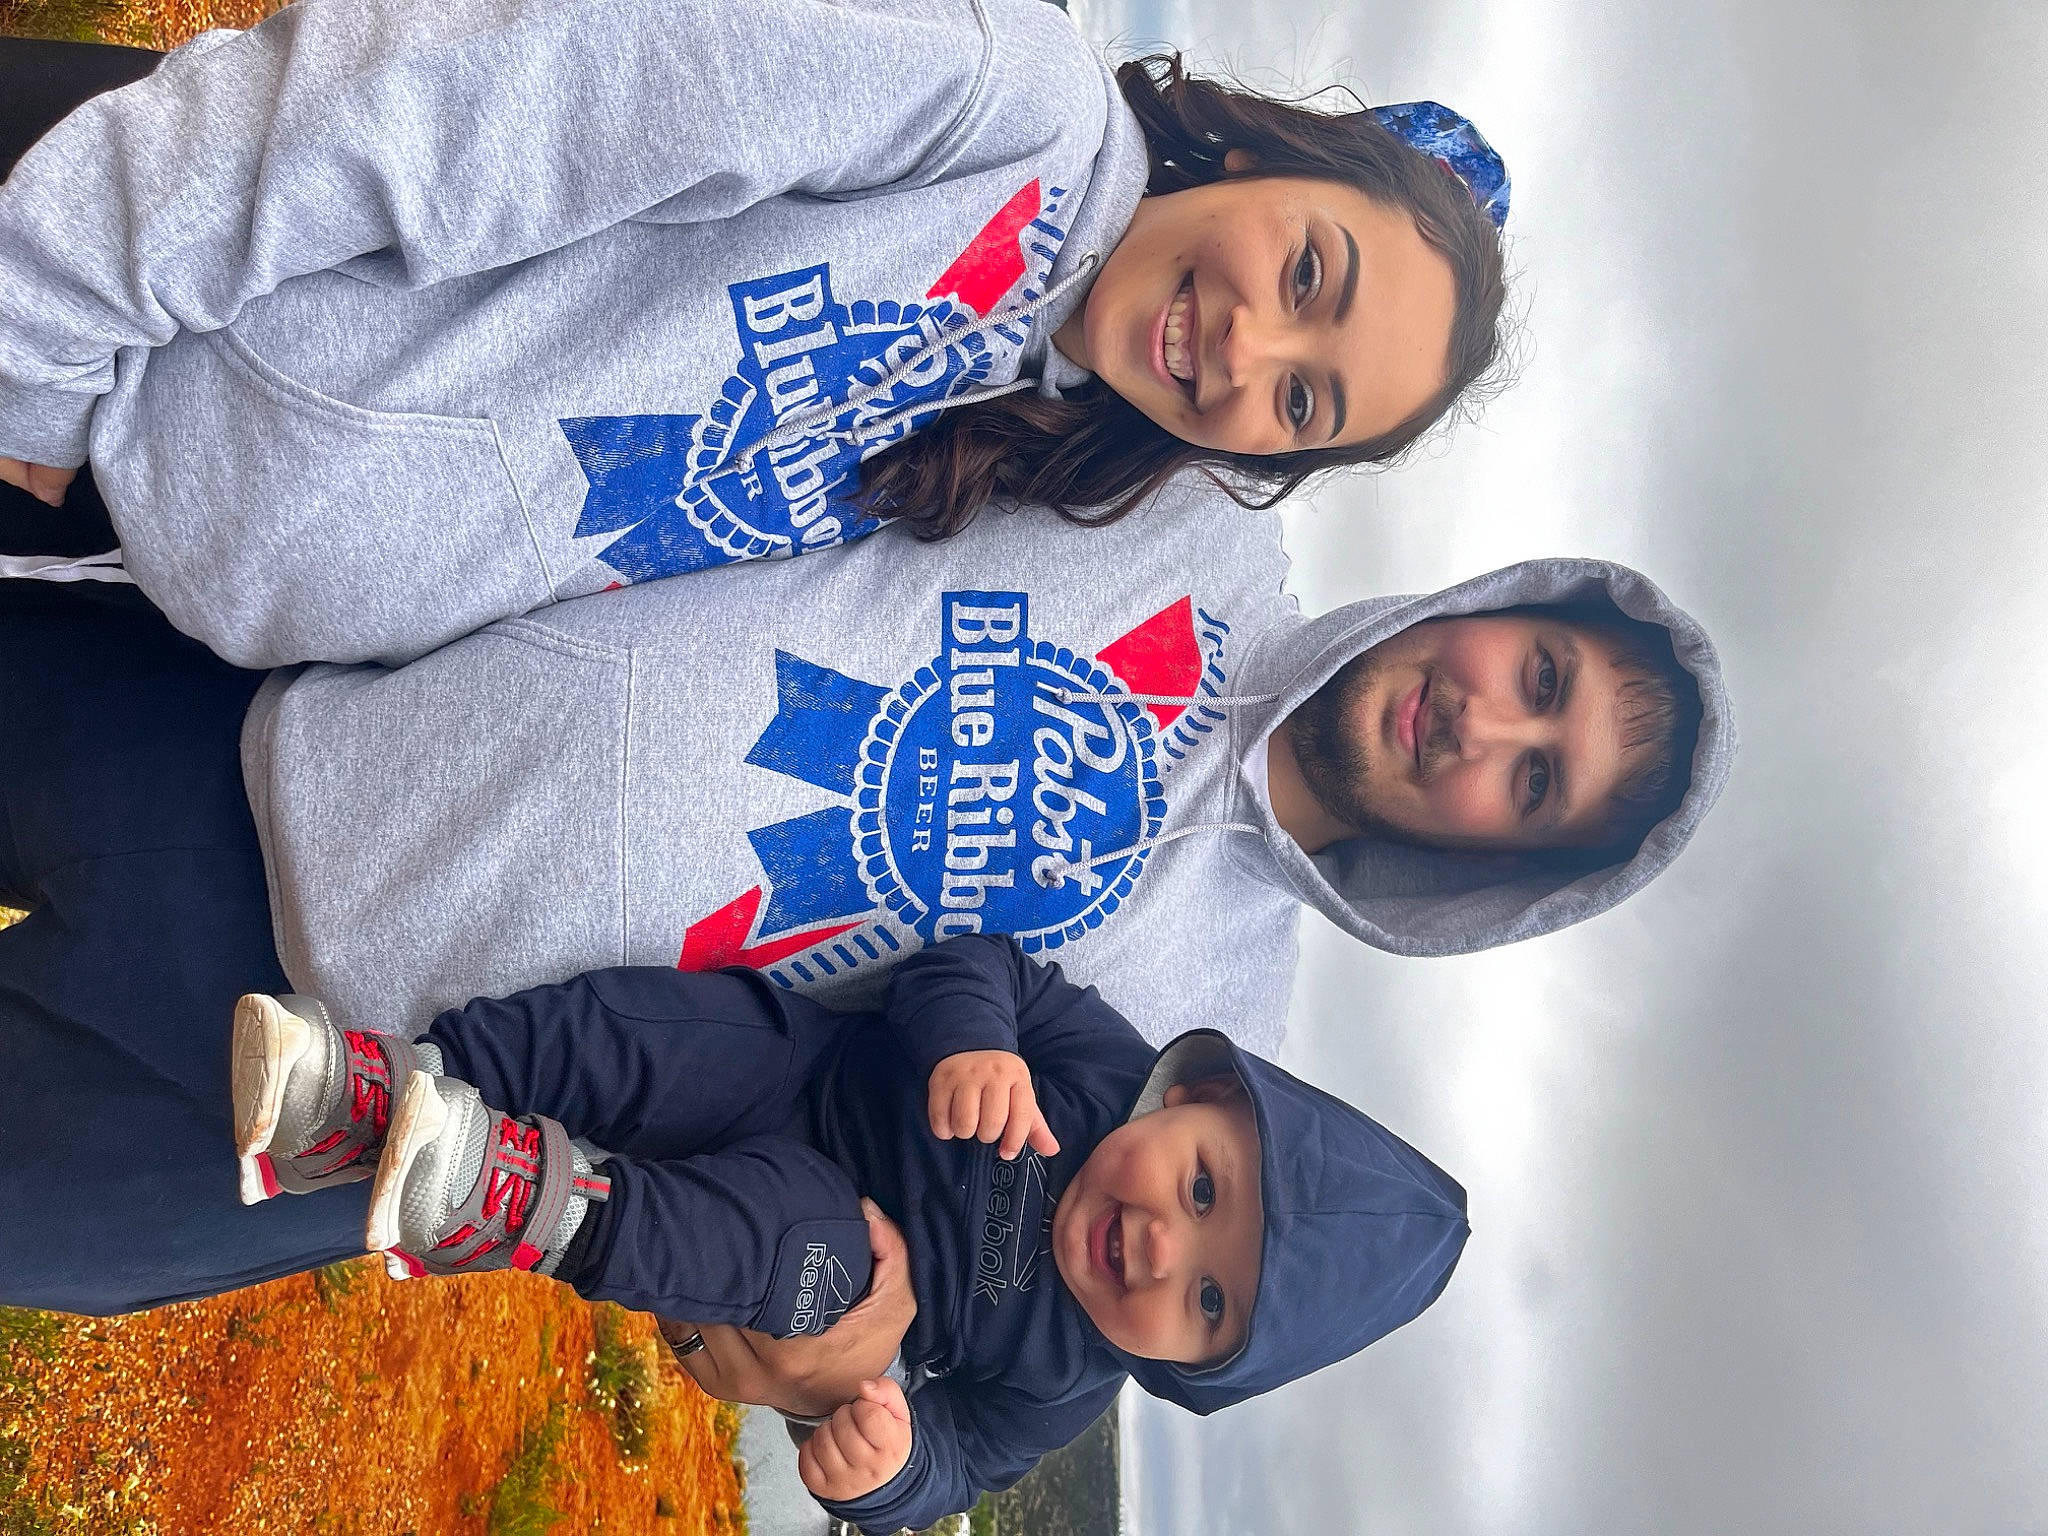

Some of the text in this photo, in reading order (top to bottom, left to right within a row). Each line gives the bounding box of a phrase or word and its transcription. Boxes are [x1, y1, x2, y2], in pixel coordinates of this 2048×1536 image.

[912, 747, 937, 852] BEER
[934, 601, 1021, 943] Blue Ribbo
[1031, 694, 1128, 896] Pabst
[973, 1143, 1027, 1306] eebok
